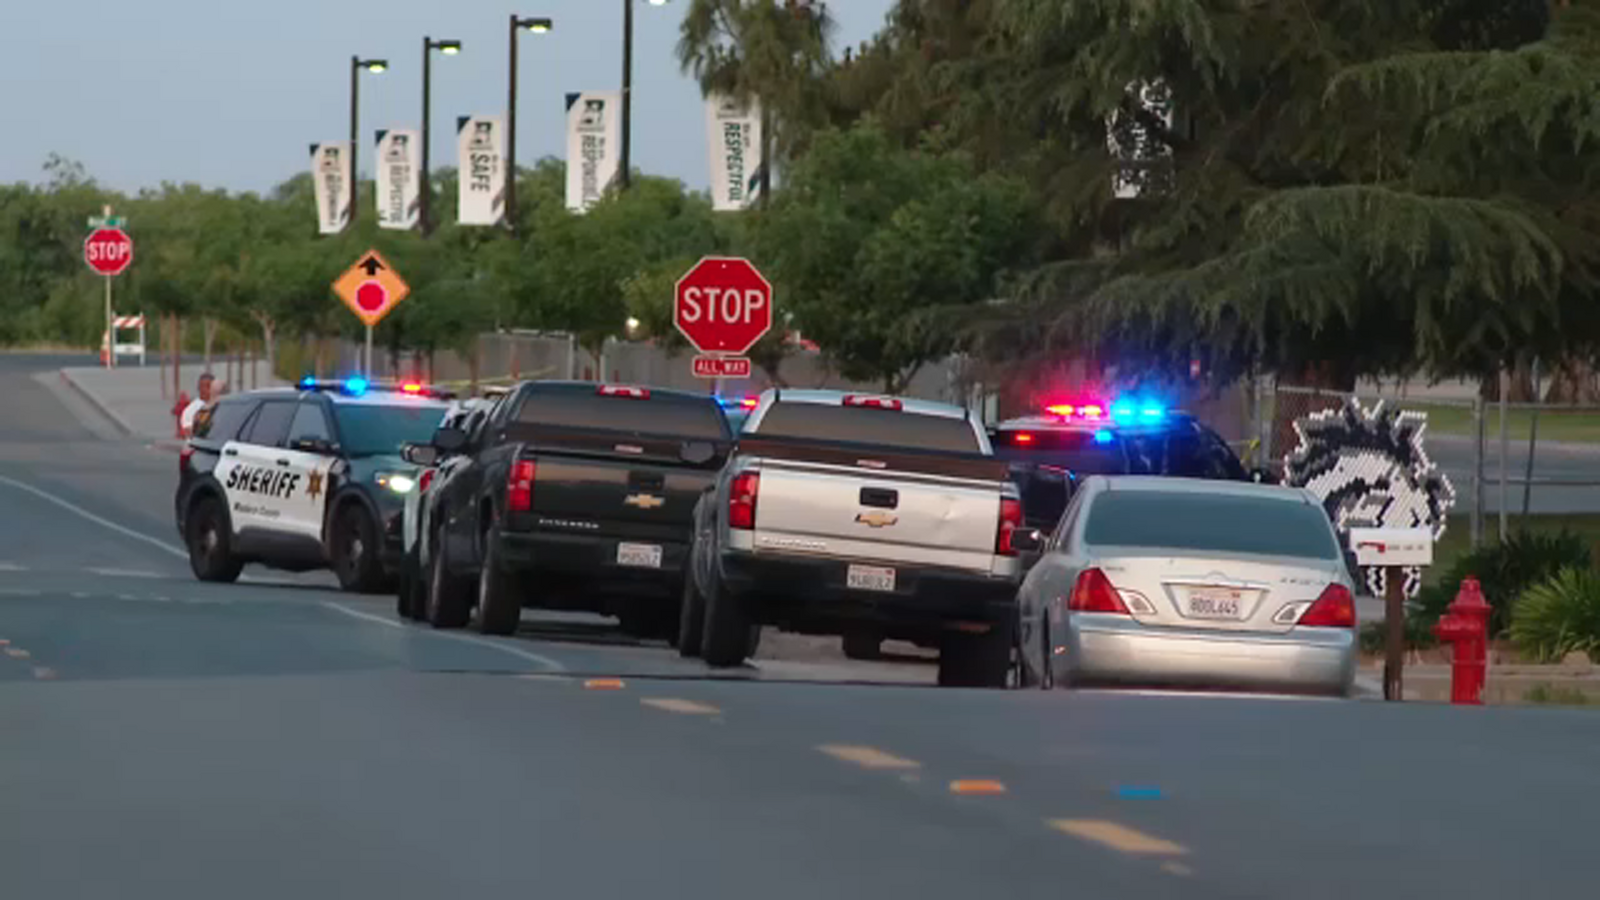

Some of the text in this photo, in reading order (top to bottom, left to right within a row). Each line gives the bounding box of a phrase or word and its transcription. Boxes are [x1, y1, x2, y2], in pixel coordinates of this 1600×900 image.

[470, 153, 492, 193] SAFE
[724, 122, 744, 202] RESPECTFUL
[89, 241, 131, 261] STOP
[681, 286, 765, 324] STOP
[697, 360, 746, 373] ALL WAY
[226, 464, 301, 499] SHERIFF
